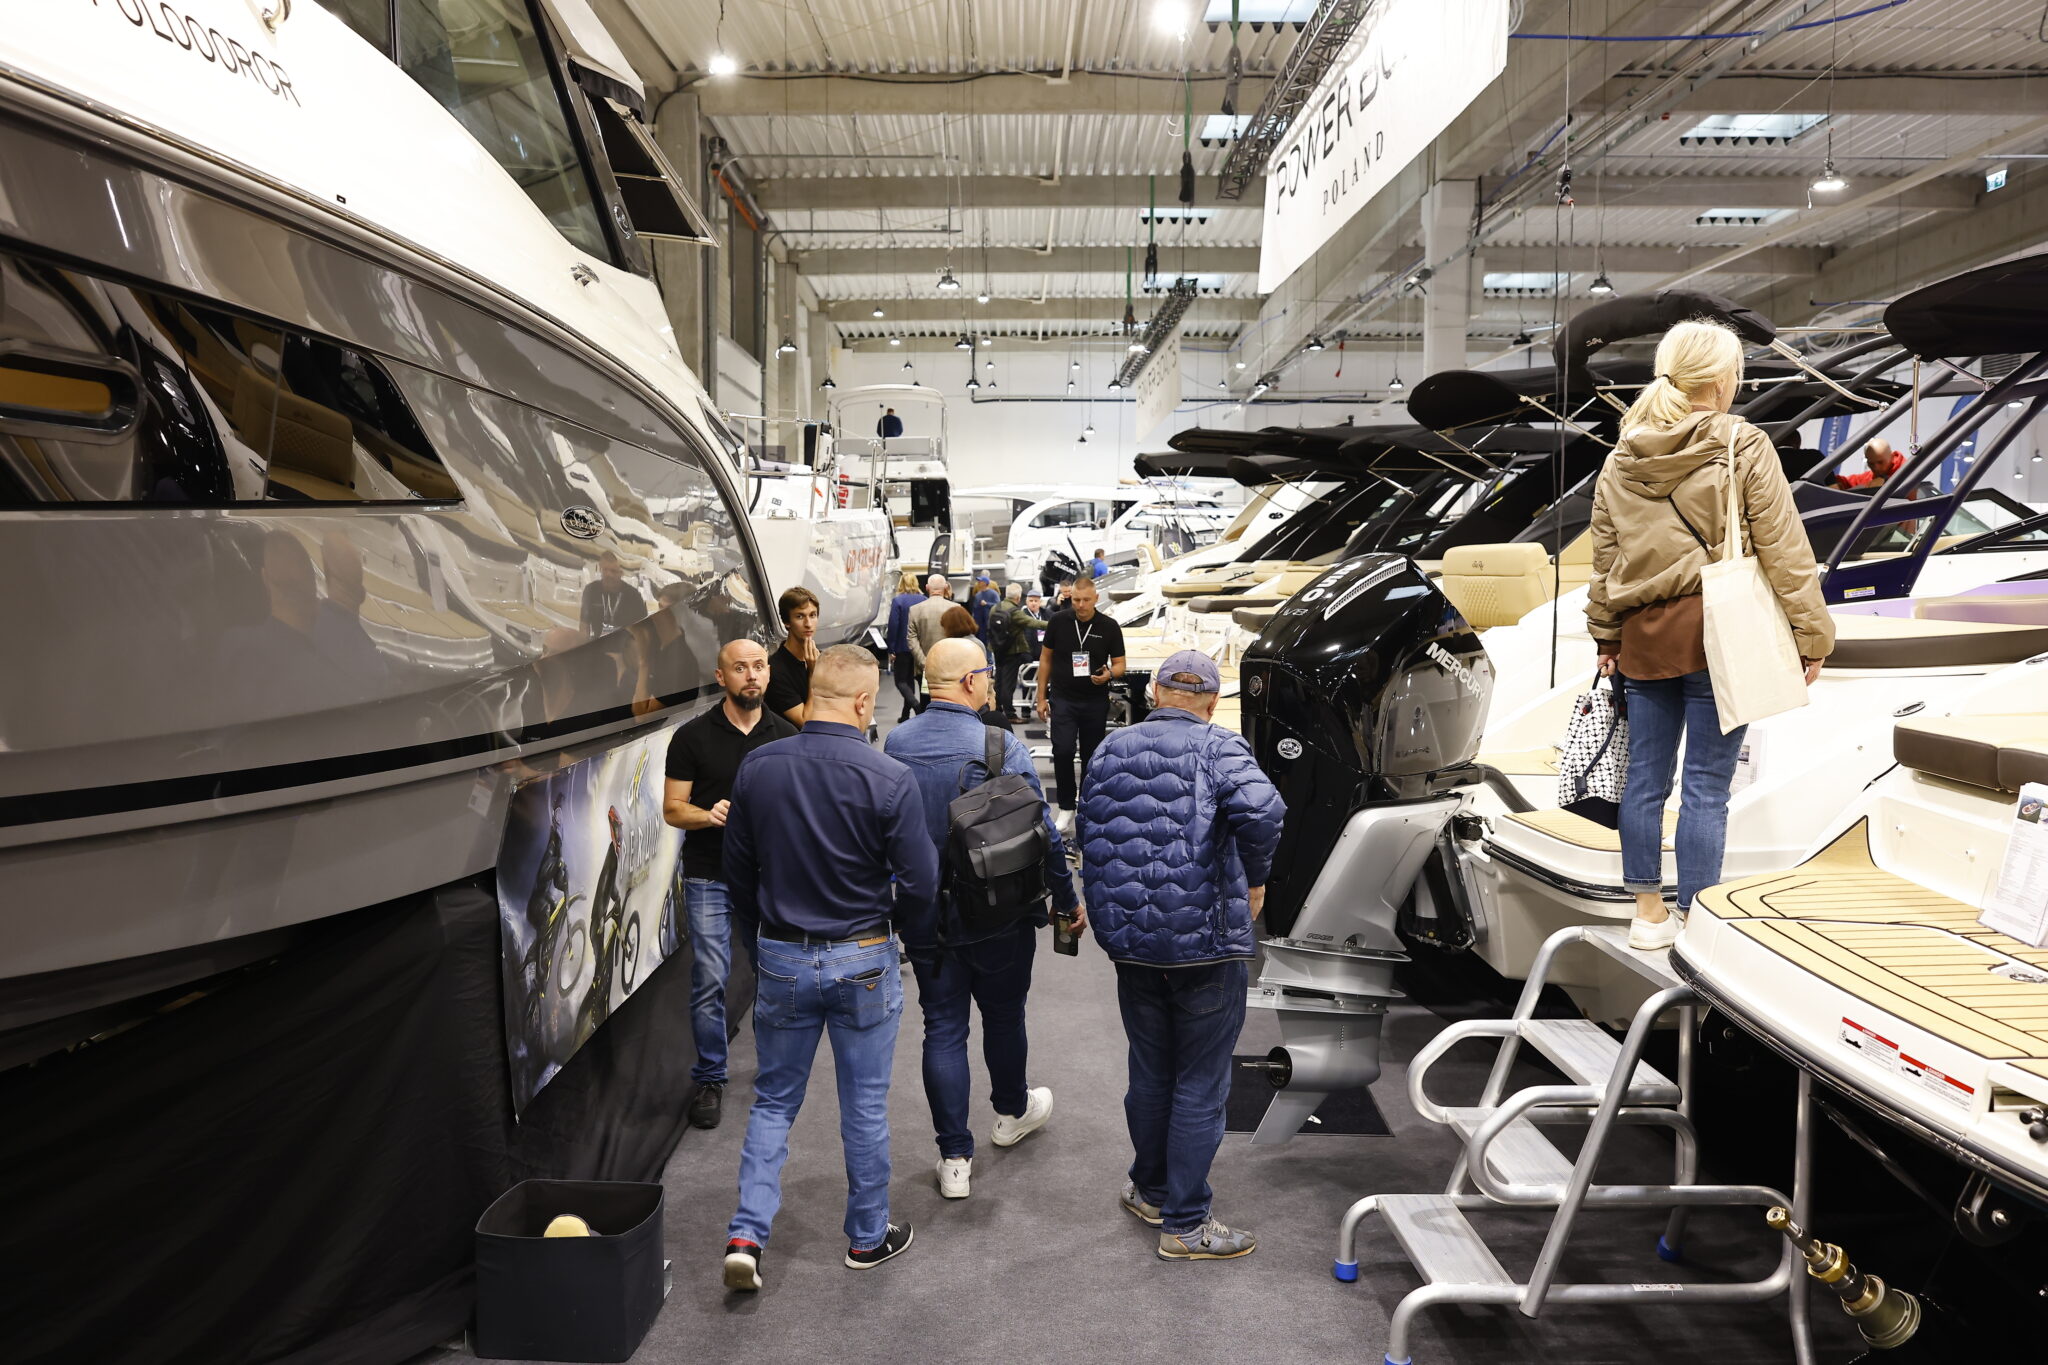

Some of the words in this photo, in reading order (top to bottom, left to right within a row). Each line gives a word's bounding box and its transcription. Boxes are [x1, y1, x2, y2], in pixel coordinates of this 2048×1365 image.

[1276, 75, 1353, 215] POWER
[1322, 131, 1384, 216] POLAND
[1425, 641, 1485, 702] MERCURY
[620, 813, 660, 880] PERUN
